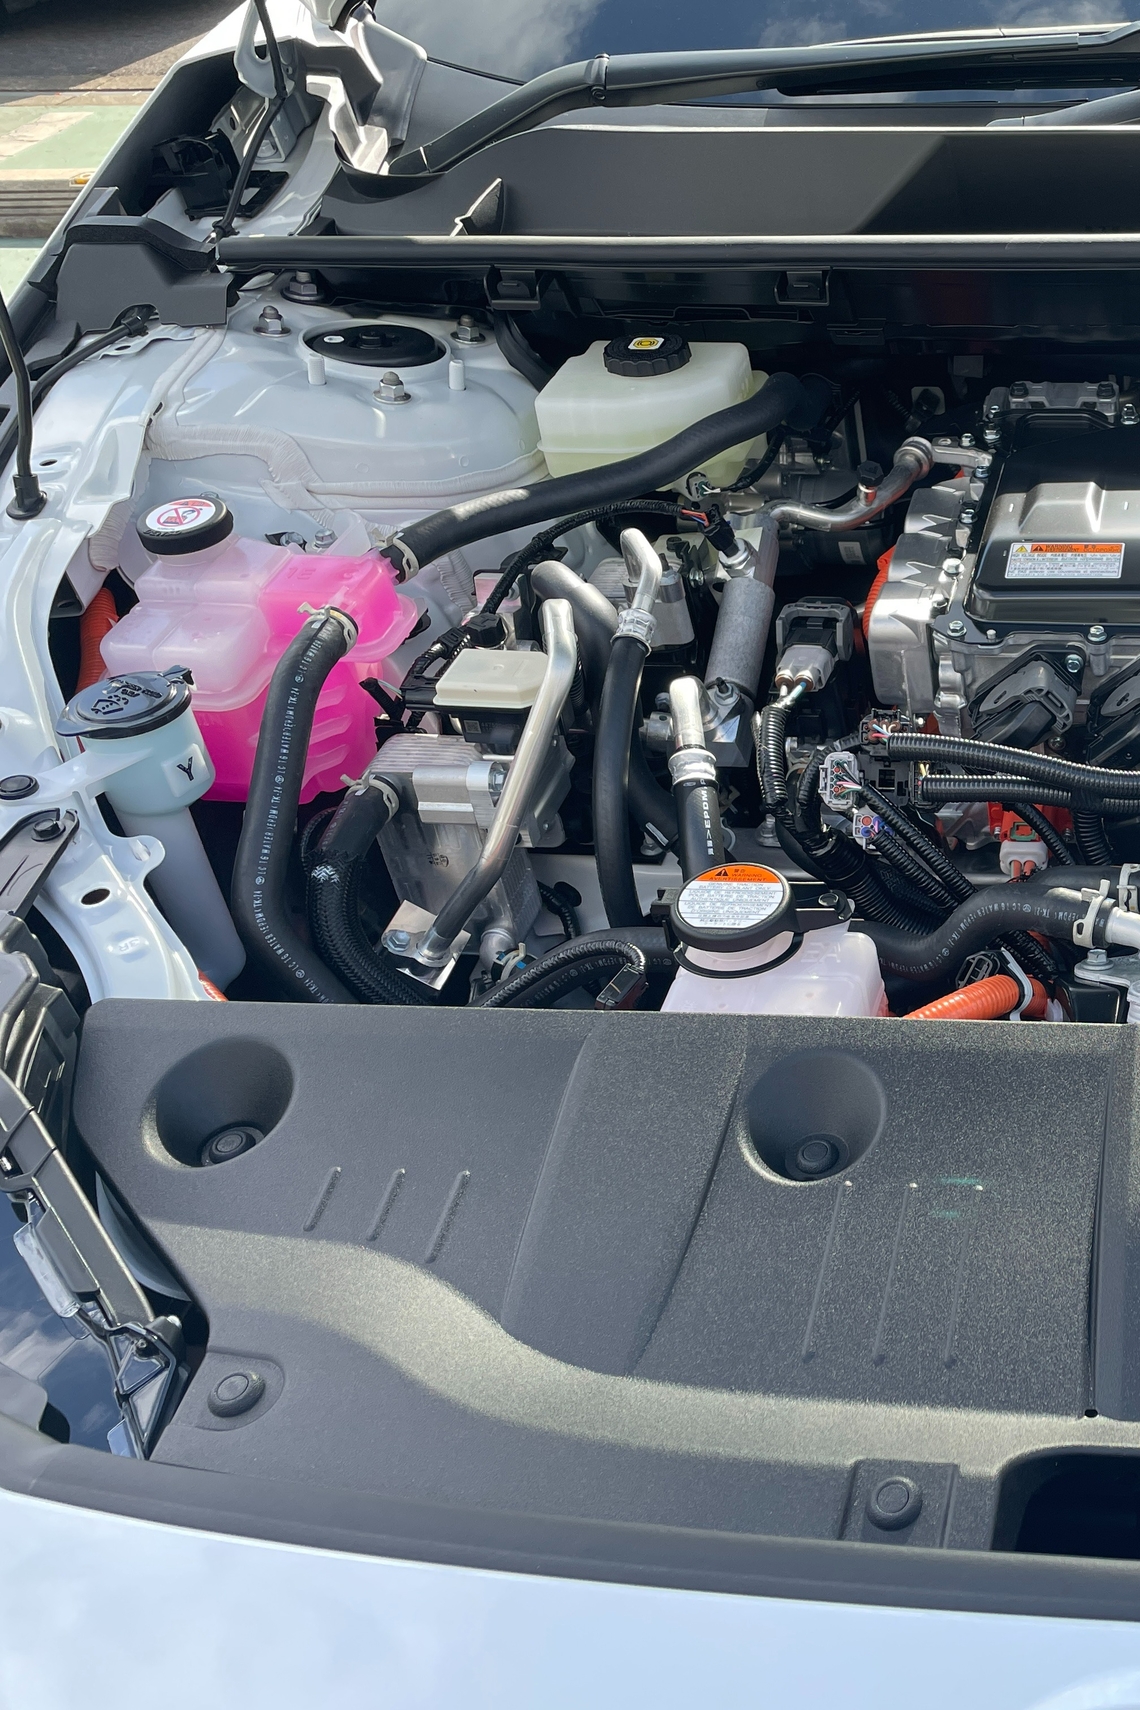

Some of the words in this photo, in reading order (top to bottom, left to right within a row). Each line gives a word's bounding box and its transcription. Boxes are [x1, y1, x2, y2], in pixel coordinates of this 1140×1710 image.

[306, 640, 323, 657] WATER
[280, 732, 292, 754] WATER
[176, 756, 194, 781] Y
[262, 832, 274, 854] WATER
[977, 903, 999, 918] WATER
[264, 934, 284, 955] WATER
